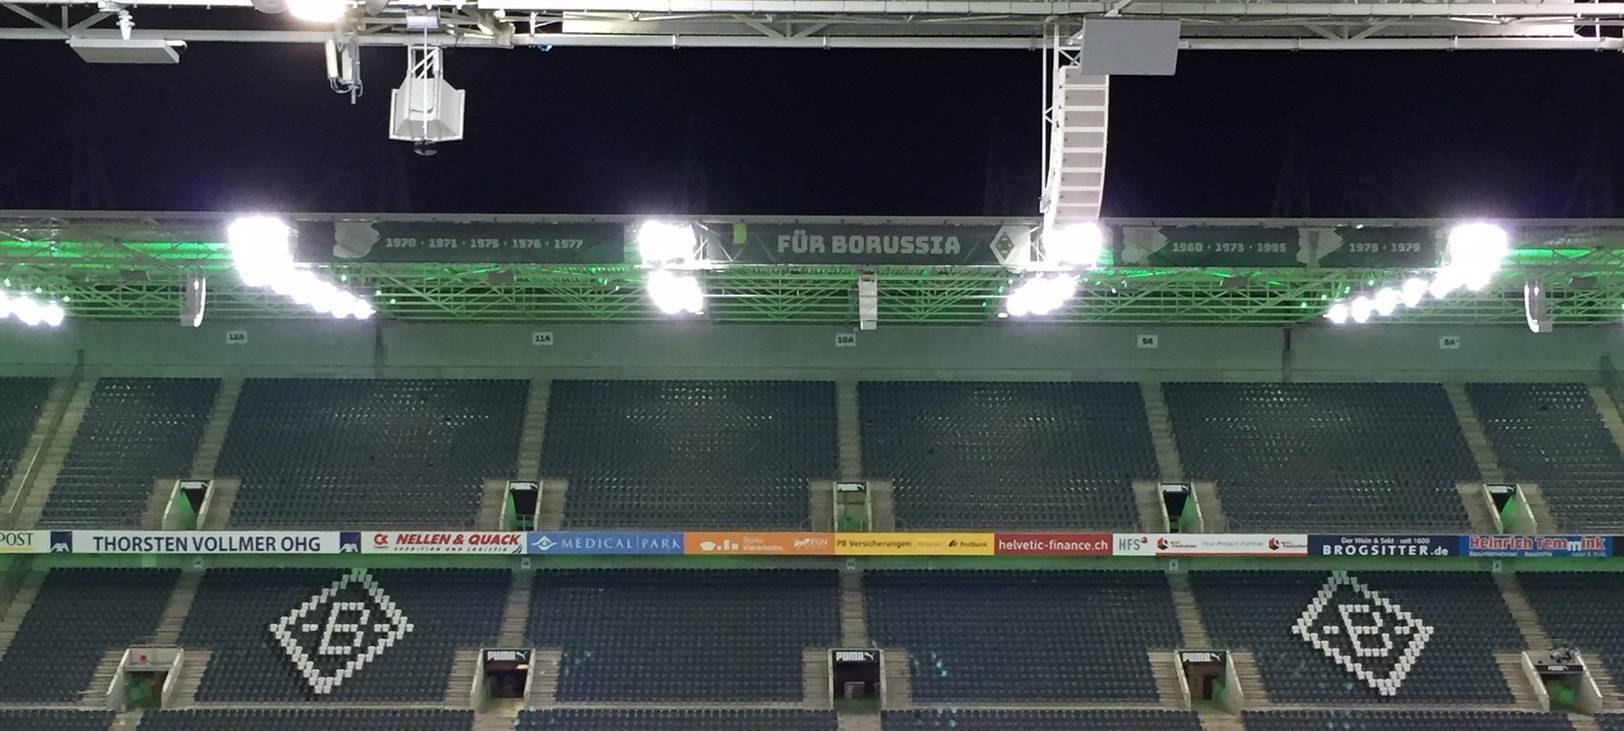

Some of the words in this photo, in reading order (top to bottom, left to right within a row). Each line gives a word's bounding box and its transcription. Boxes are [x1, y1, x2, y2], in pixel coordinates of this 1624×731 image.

[386, 238, 417, 248] 1970
[429, 238, 458, 249] 1971
[512, 238, 542, 249] 1976
[554, 238, 584, 249] 1977
[777, 229, 825, 254] FÜR
[831, 235, 961, 255] BORUSSIA
[93, 536, 188, 552] THORSTEN
[192, 536, 276, 552] VOLLMER
[280, 537, 321, 552] OHG
[396, 533, 452, 545] NELLEN
[453, 534, 464, 545] &
[468, 534, 521, 545] QUACK
[561, 538, 633, 549] MEDICAL
[642, 538, 681, 549] PARK
[849, 539, 912, 549] Versicherungen
[998, 538, 1109, 551] helvetic-finance.ch
[1119, 538, 1140, 551] HFS
[1469, 535, 1534, 550] Heinrich
[1322, 544, 1449, 556] BROGSITTER.de
[487, 651, 516, 661] PUMA
[836, 651, 864, 661] PUMA
